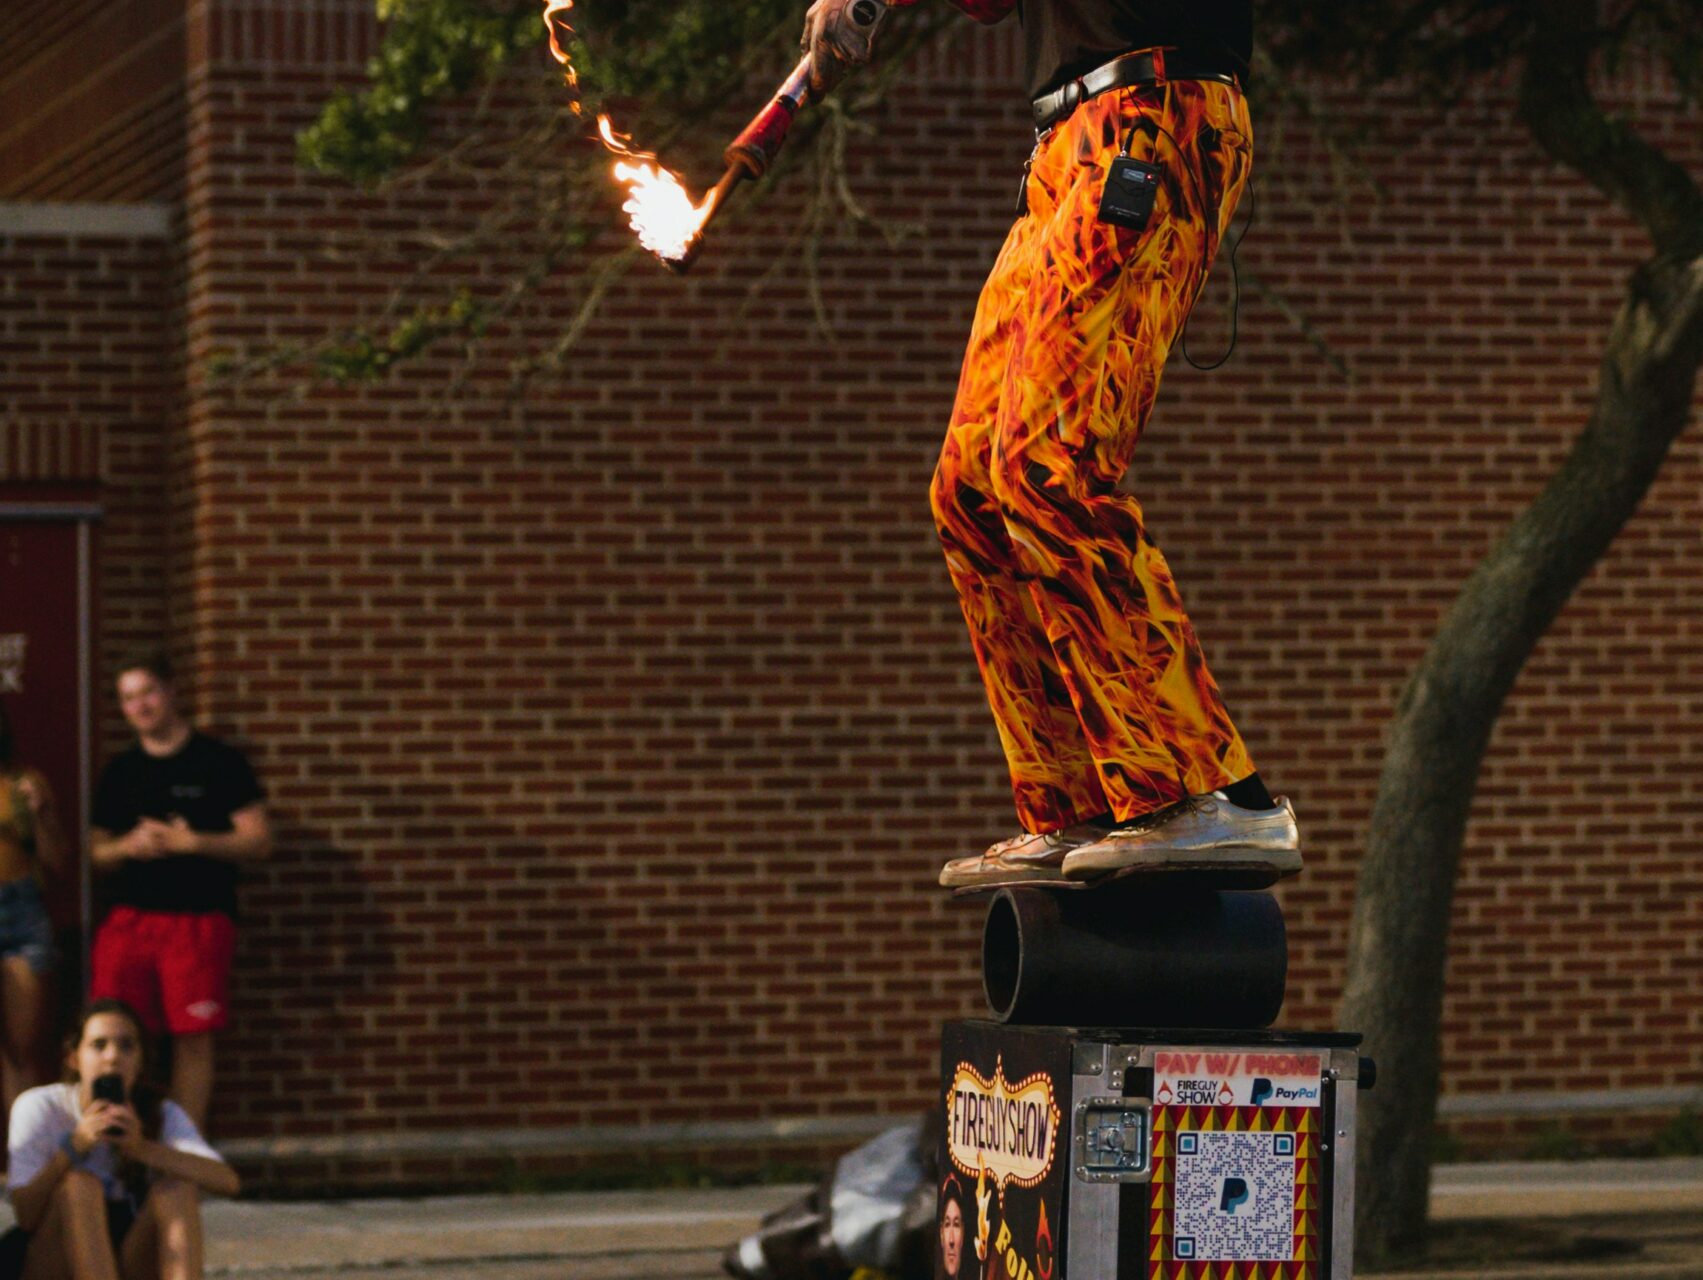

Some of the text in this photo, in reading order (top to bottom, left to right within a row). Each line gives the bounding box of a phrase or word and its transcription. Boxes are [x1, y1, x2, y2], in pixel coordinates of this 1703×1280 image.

[1155, 1053, 1321, 1076] PAY W/ PHONE
[1177, 1080, 1218, 1090] FIREGUY
[1177, 1091, 1218, 1105] SHOW
[1276, 1088, 1317, 1100] PayPal
